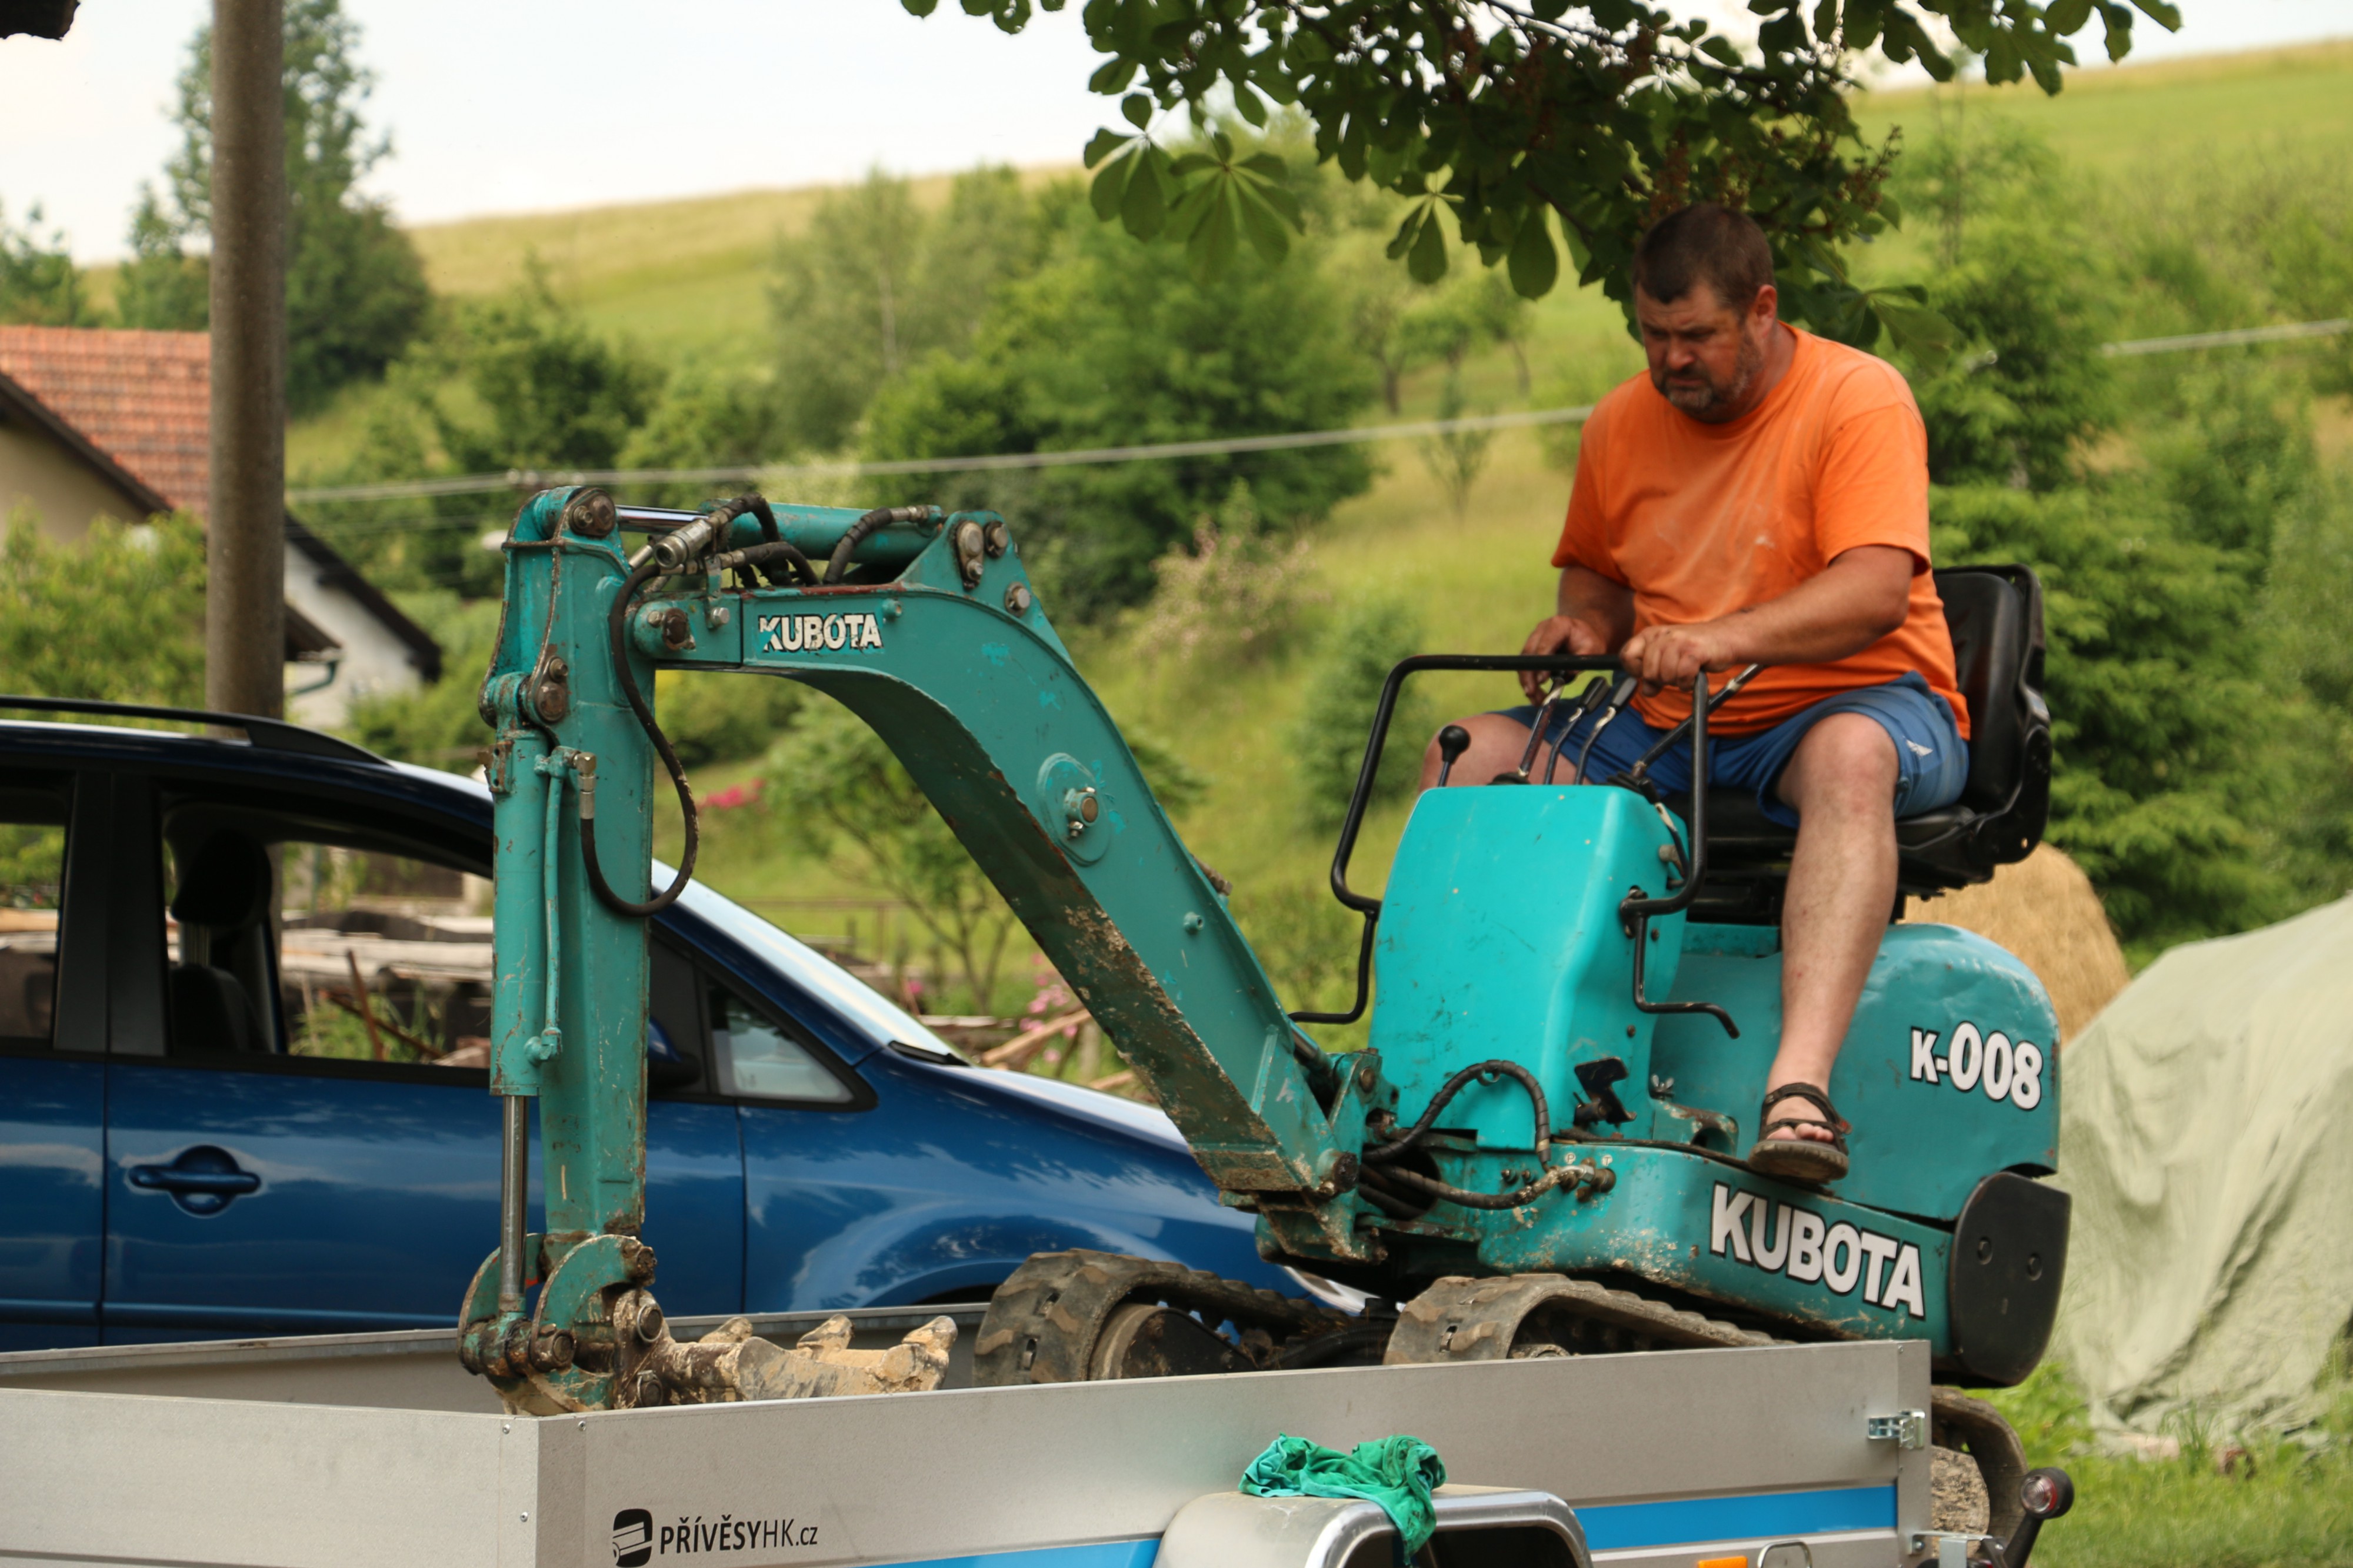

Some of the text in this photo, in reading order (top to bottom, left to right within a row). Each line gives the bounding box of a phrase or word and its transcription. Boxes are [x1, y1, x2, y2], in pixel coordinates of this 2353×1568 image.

[759, 613, 882, 651] KUBOTA
[1911, 1021, 2043, 1110] K-008
[1567, 1154, 1575, 1163] P
[1604, 1156, 1611, 1165] T
[1711, 1183, 1925, 1317] KUBOTA
[660, 1514, 818, 1554] PŘÍVĚSYHK.cz
